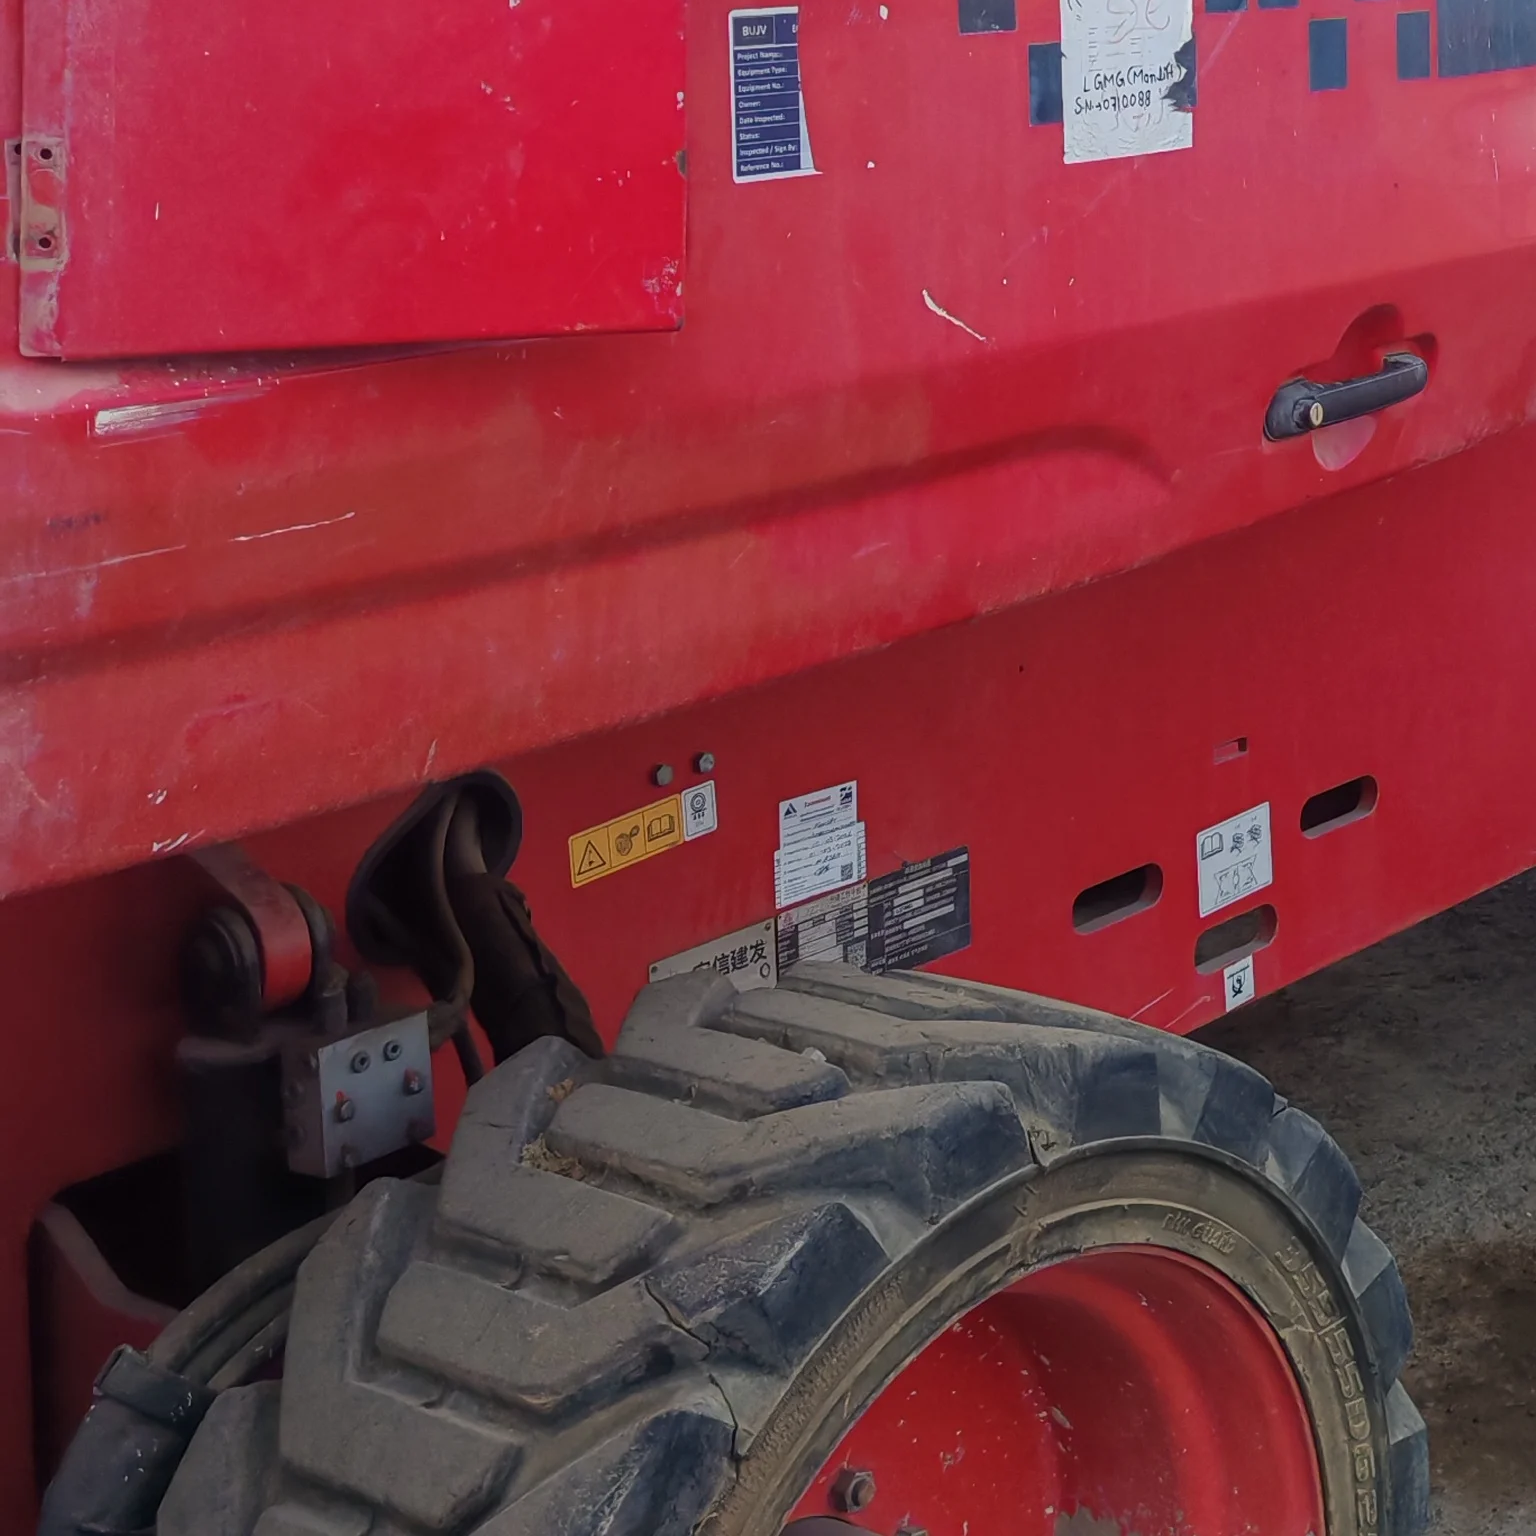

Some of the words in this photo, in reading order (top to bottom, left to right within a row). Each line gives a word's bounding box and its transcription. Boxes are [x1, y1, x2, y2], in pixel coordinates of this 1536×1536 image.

[742, 25, 767, 37] BUJV
[737, 51, 759, 61] Project
[737, 67, 770, 77] Equipment
[771, 66, 788, 75] Type:
[738, 83, 771, 93] Equipment
[739, 100, 761, 109] Owner:
[739, 116, 753, 125] Date
[754, 113, 786, 124] Inspected:
[739, 131, 761, 141] Status:
[740, 146, 769, 157] Inspected
[740, 162, 770, 172] Reference
[692, 939, 767, 975] 信建发
[1275, 1235, 1379, 1536] 355/55D62
